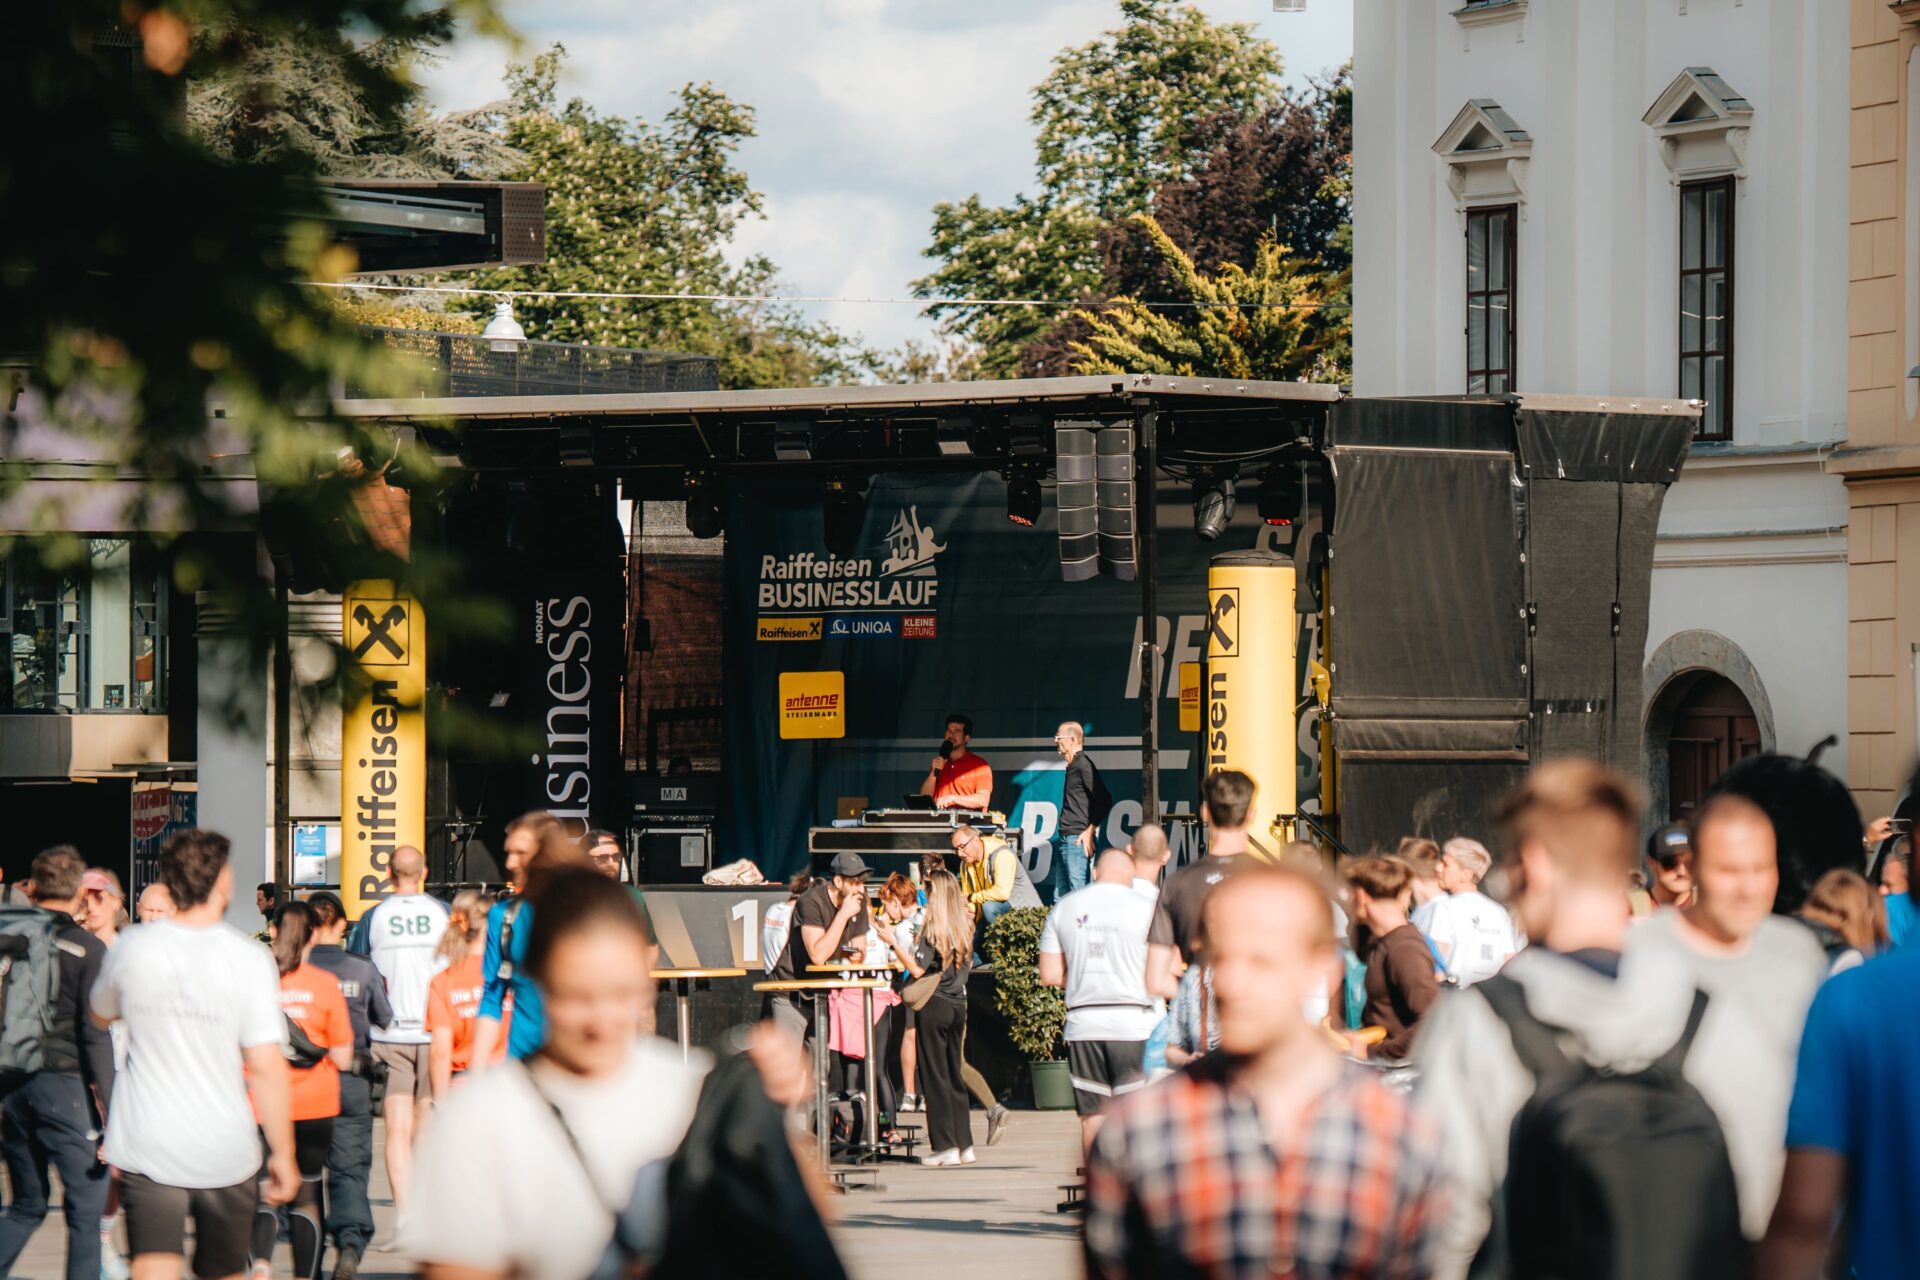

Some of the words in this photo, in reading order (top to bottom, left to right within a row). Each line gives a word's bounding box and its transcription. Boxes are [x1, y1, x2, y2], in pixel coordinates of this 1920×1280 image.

[760, 553, 873, 580] Raiffeisen
[758, 580, 938, 608] BUSINESSLAUF
[535, 600, 544, 644] MONAT
[852, 620, 893, 635] UNIQA
[903, 627, 935, 637] ZEITUNG
[904, 618, 935, 628] KLEINE
[760, 627, 808, 640] Raiffeisen
[785, 692, 839, 707] antenne
[357, 679, 399, 901] Raiffeisen
[389, 915, 432, 936] StB
[731, 899, 759, 962] 1
